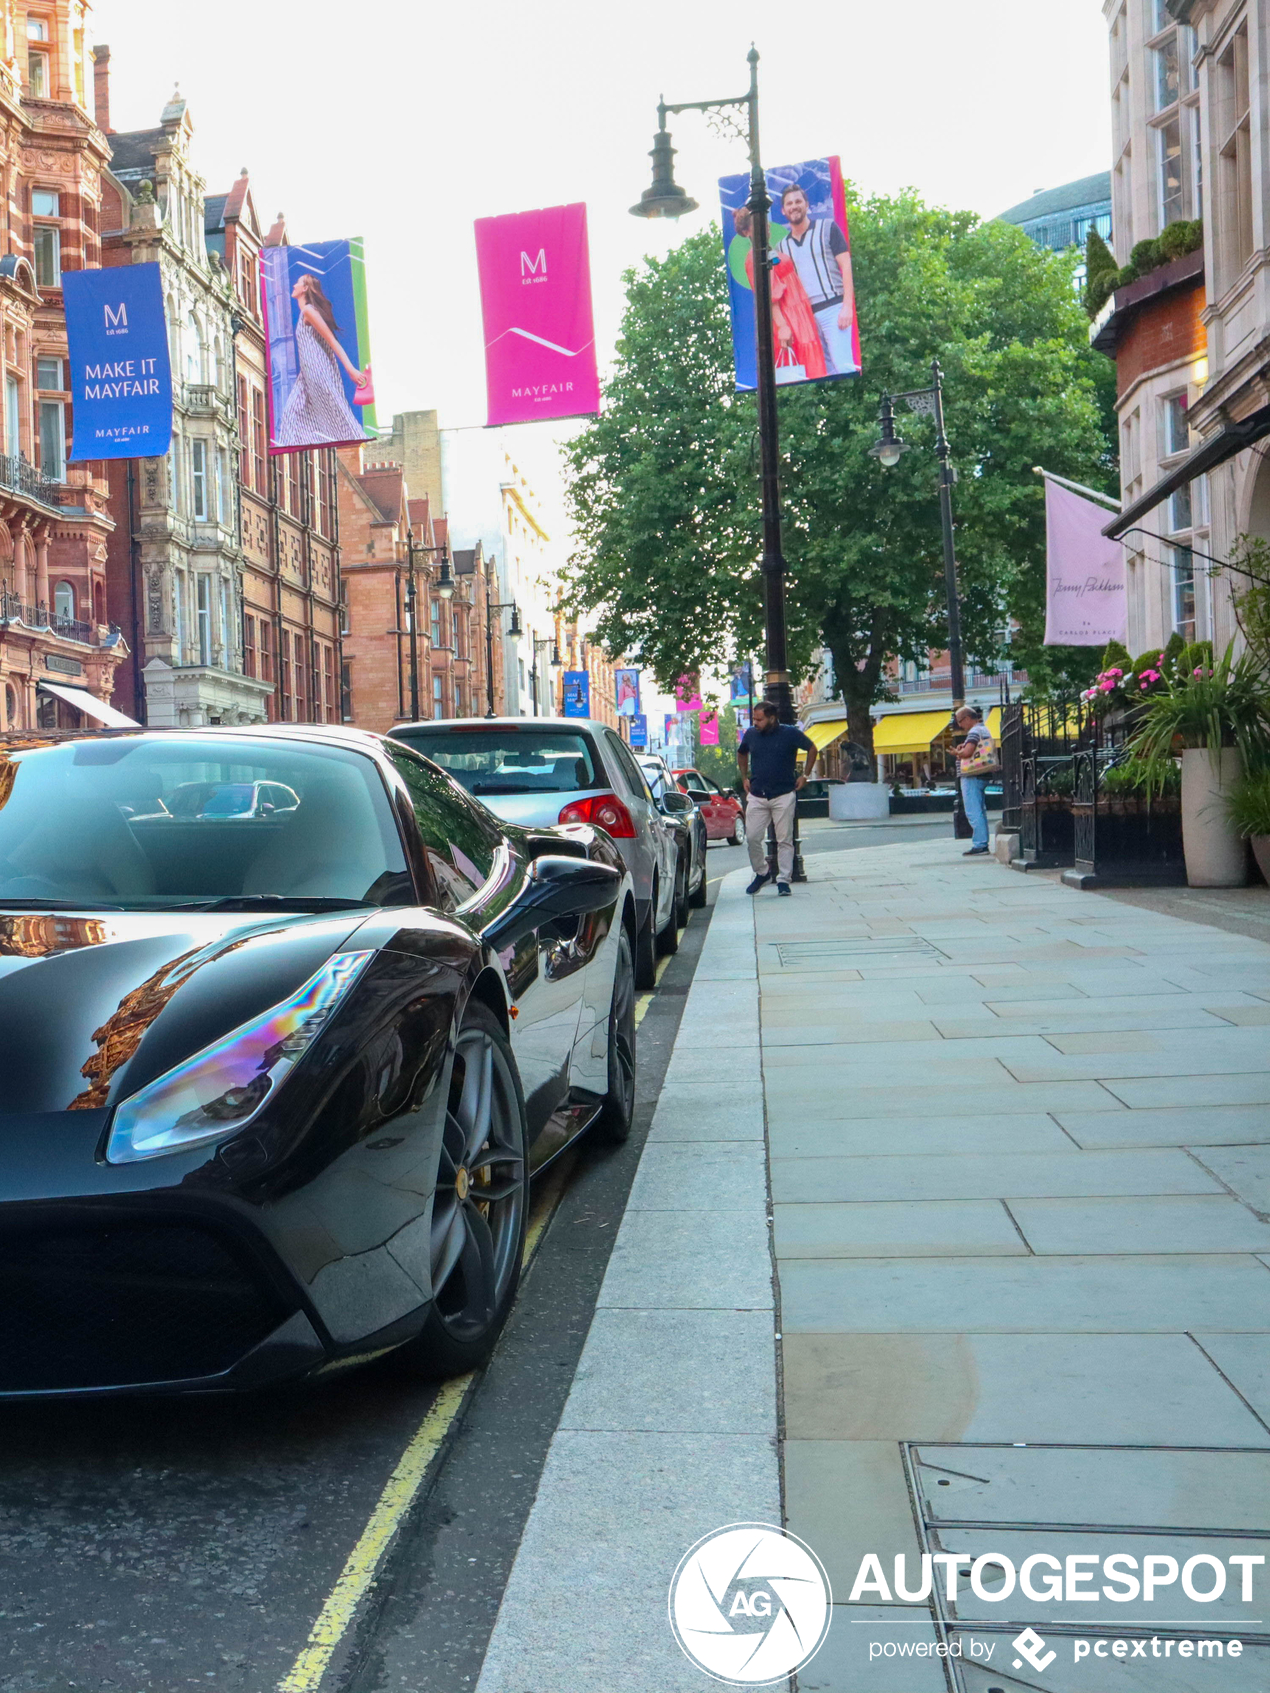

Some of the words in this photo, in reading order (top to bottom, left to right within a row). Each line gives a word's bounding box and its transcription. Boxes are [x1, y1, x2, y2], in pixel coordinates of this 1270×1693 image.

[520, 248, 547, 276] M
[104, 302, 128, 328] M
[85, 360, 135, 380] MAKE
[141, 358, 157, 375] IT
[85, 378, 160, 401] MAYFAIR
[511, 381, 574, 398] MAYFAIR
[95, 425, 150, 438] MAYFAIR
